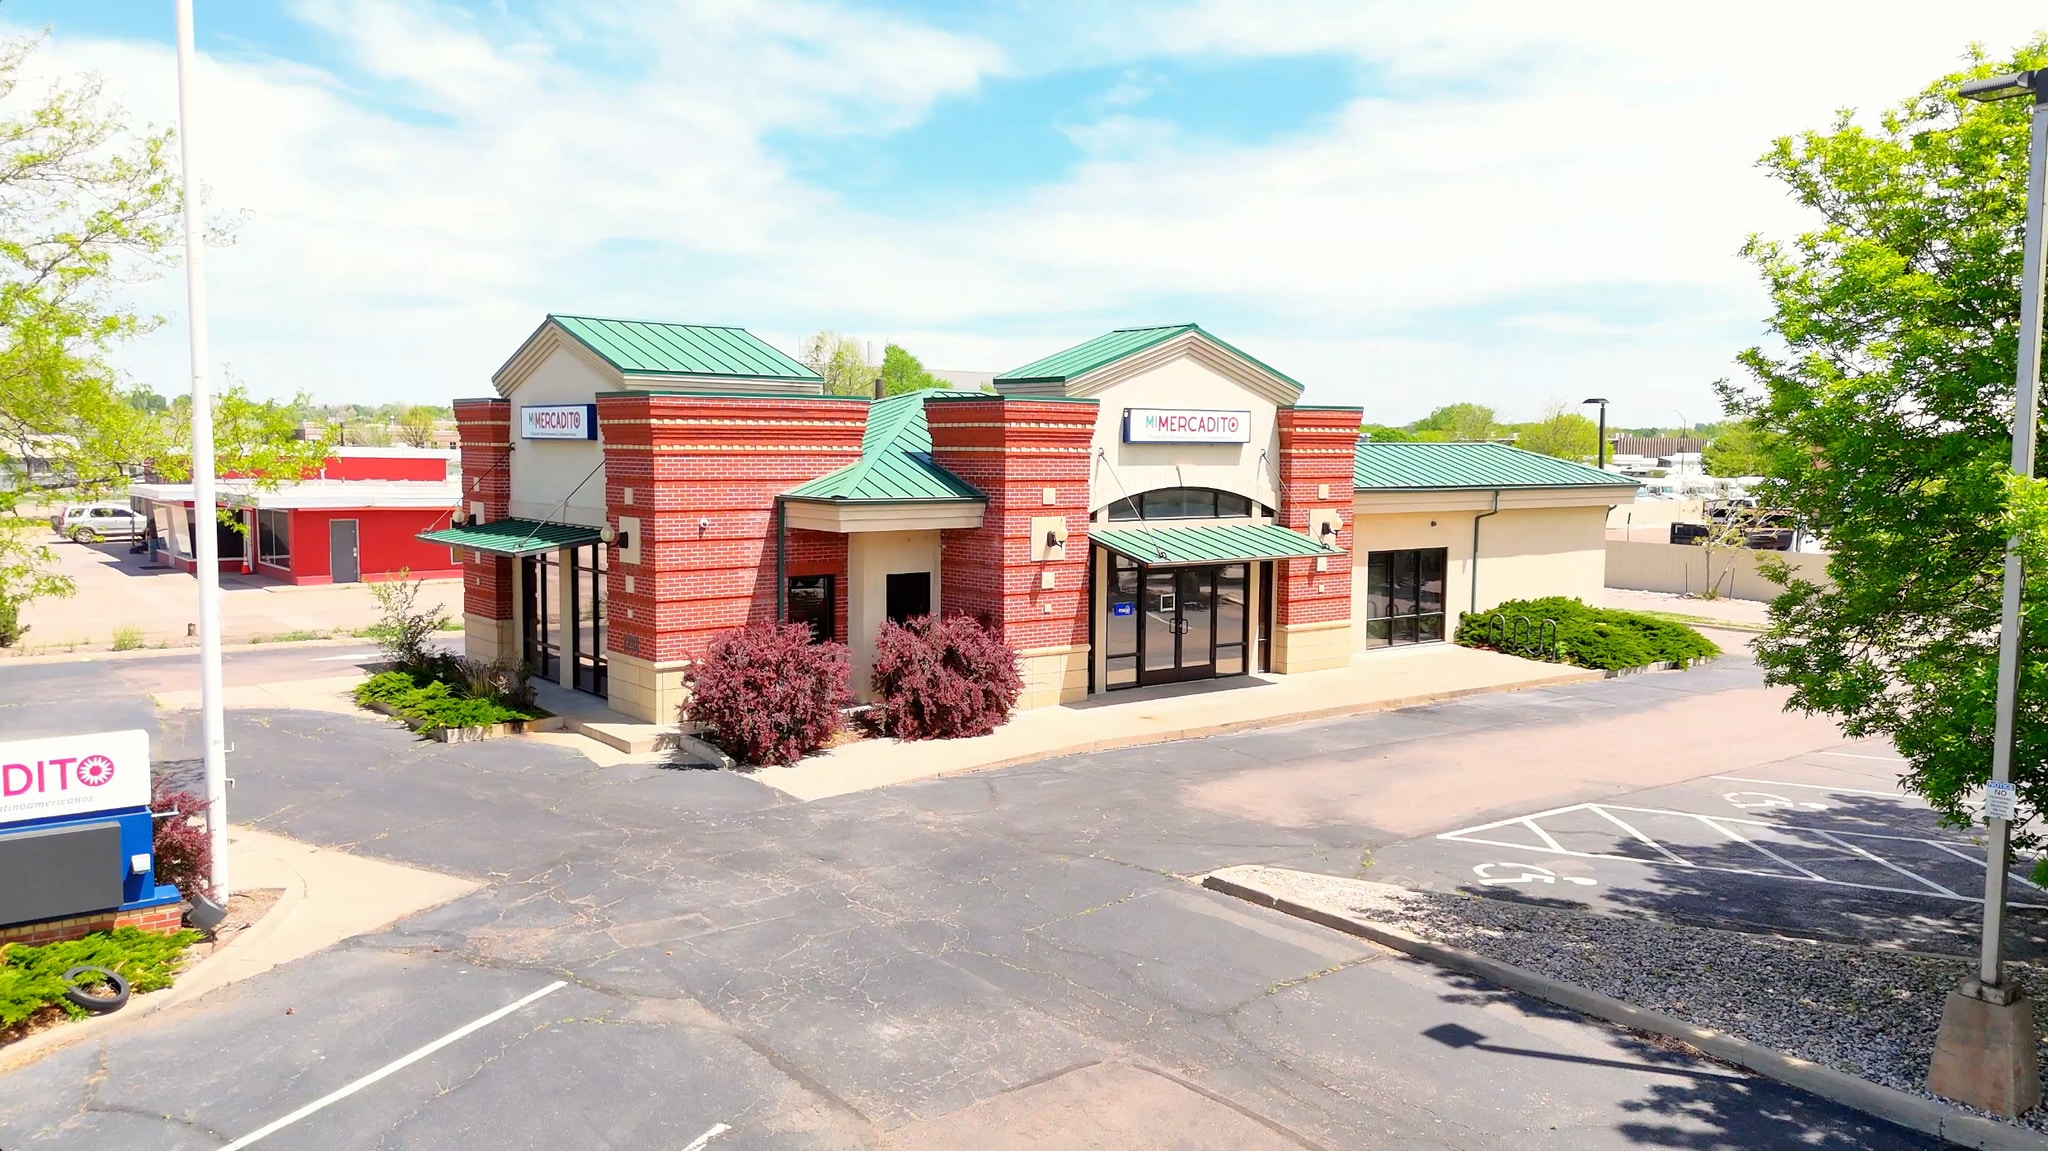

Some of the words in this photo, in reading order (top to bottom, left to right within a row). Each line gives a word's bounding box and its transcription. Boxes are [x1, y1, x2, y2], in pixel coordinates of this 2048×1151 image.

[535, 411, 581, 429] MERCADITO
[1158, 415, 1239, 432] MERCADITO
[1989, 781, 2014, 791] NOTICE
